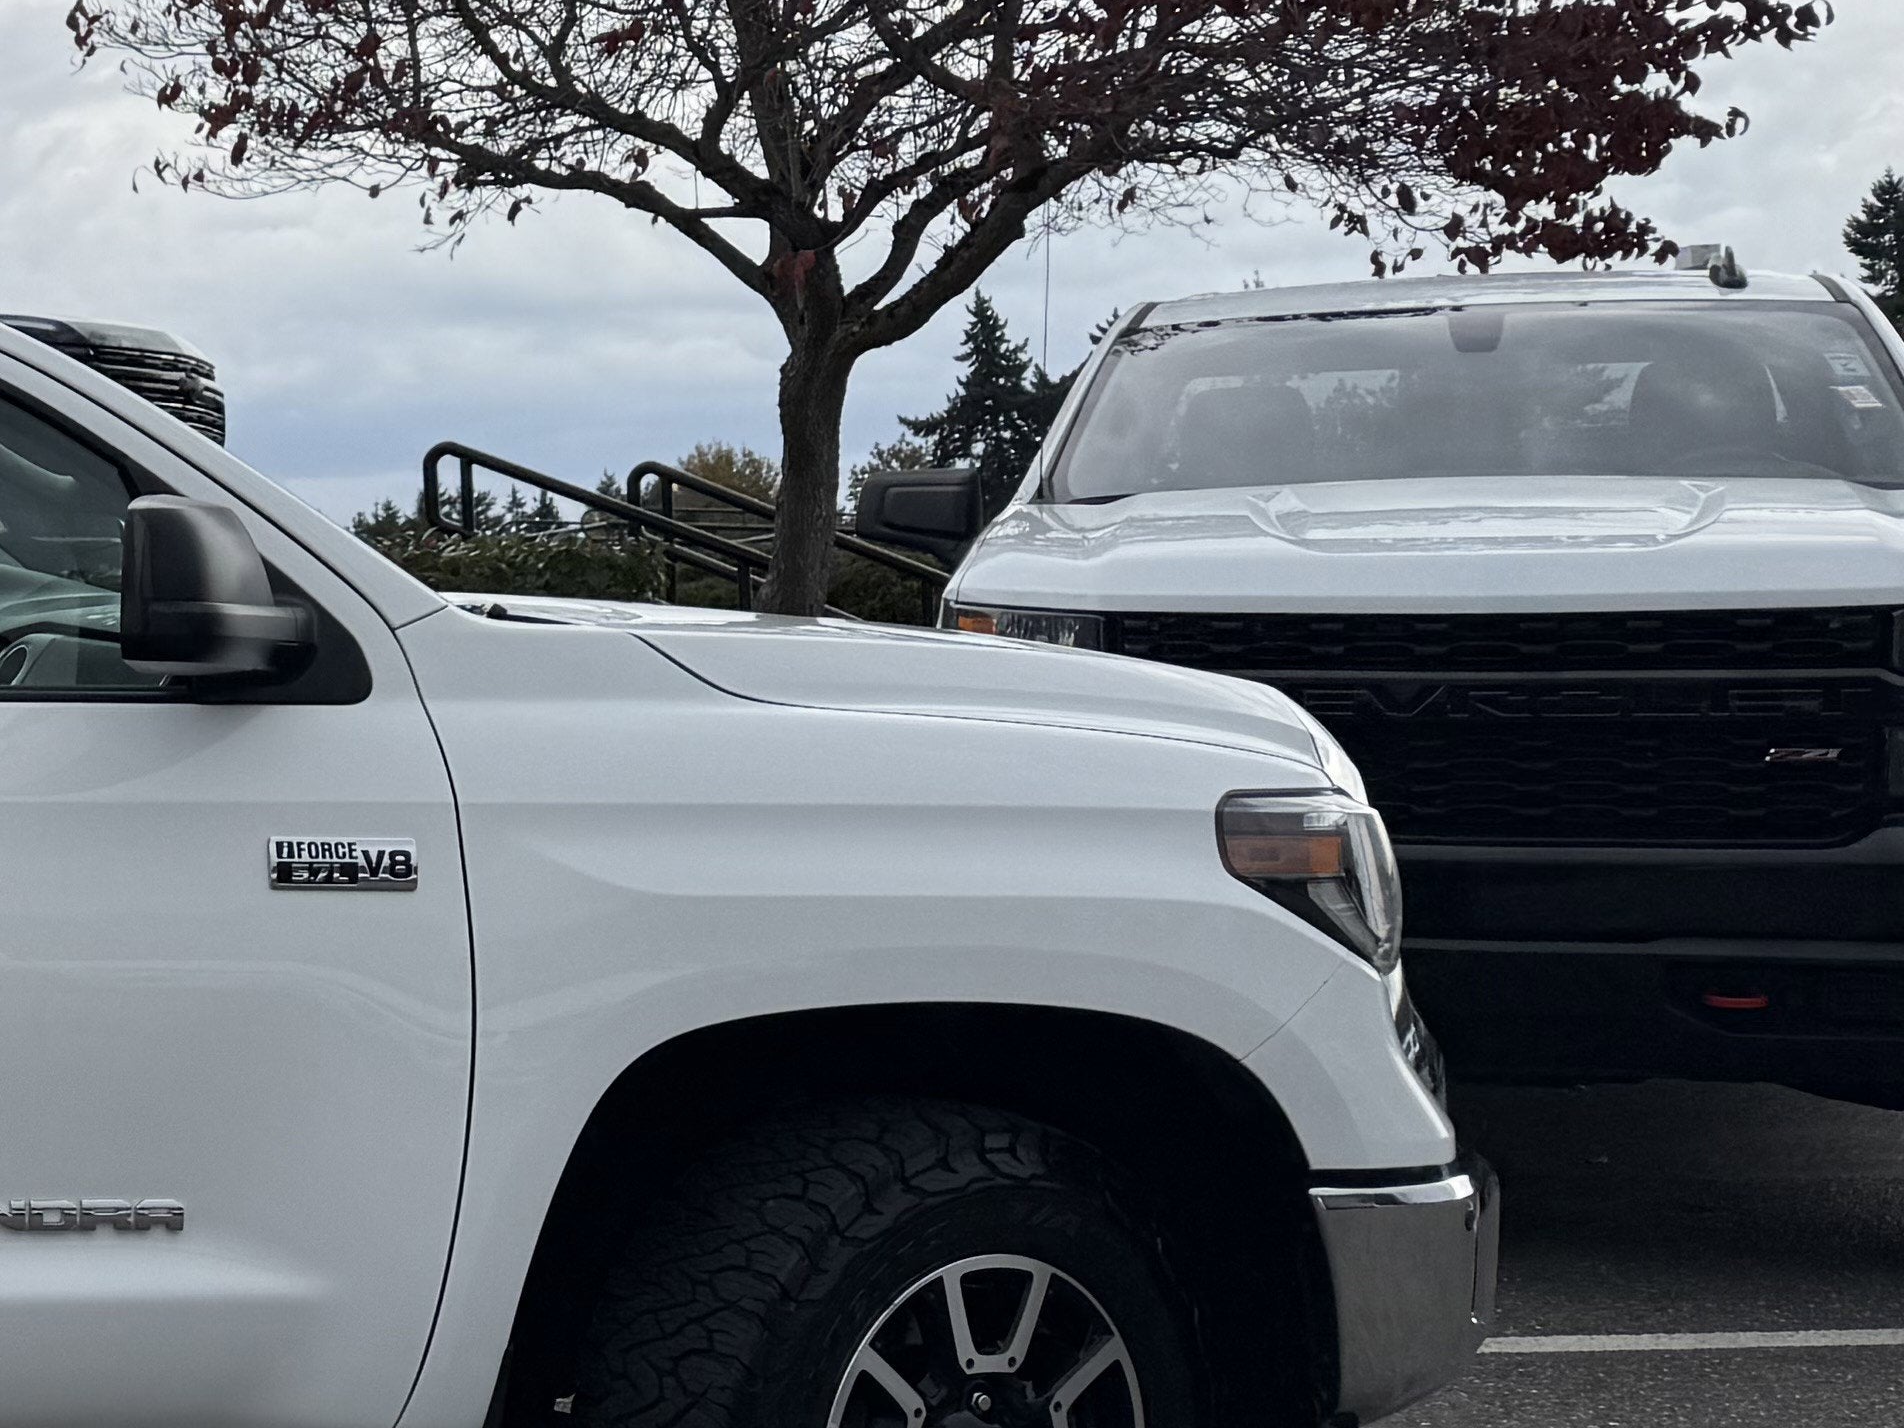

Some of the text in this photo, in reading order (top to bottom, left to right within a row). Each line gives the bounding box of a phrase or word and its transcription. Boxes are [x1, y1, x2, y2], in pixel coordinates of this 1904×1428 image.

[1305, 685, 1874, 718] EVROLET
[291, 863, 350, 882] 5.7L
[360, 849, 413, 880] V8
